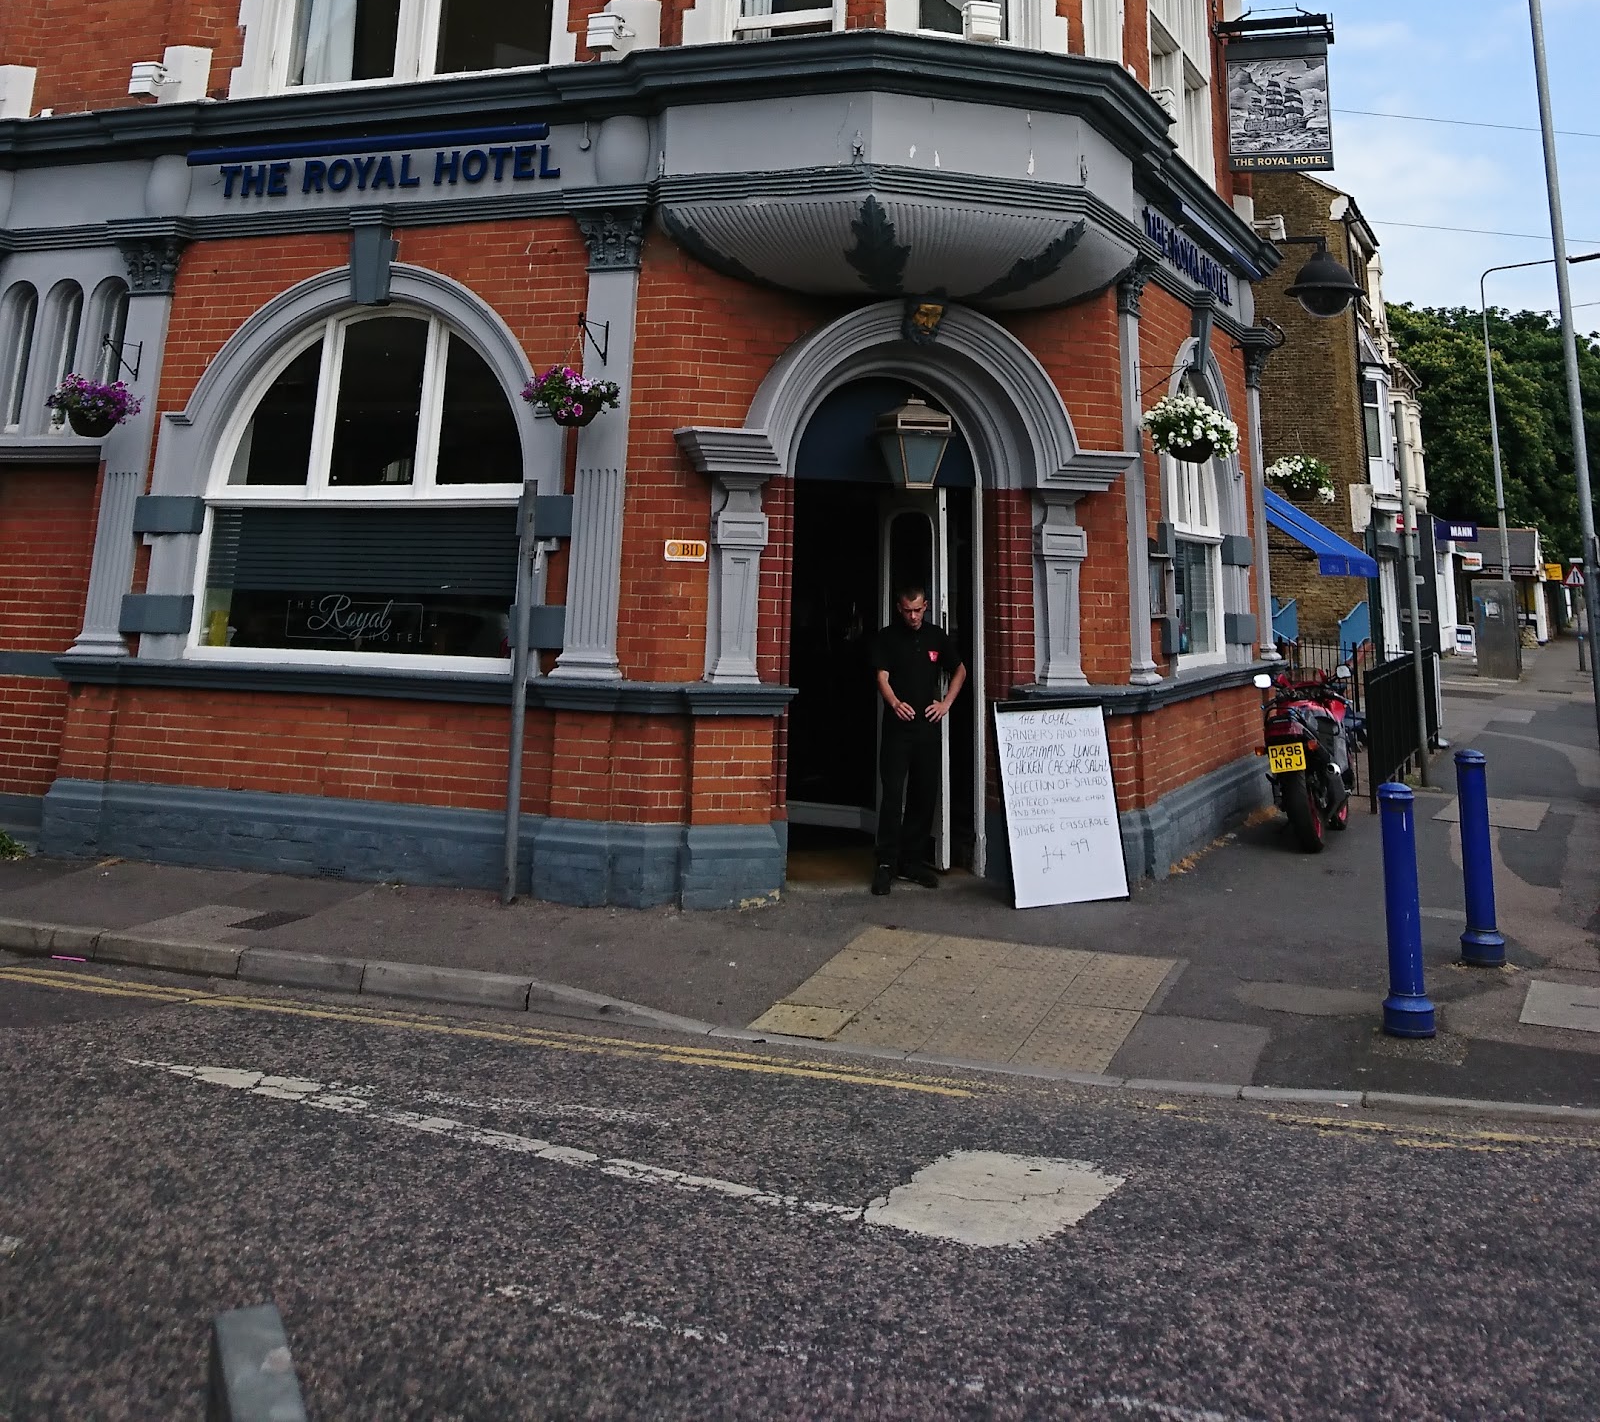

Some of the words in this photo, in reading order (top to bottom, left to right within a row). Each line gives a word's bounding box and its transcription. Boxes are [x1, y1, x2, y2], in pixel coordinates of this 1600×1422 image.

[1234, 158, 1254, 166] THE
[1257, 157, 1291, 166] ROYAL
[1293, 155, 1328, 165] HOTEL
[220, 161, 290, 197] THE
[302, 153, 420, 194] ROYAL
[433, 144, 561, 185] HOTEL
[1142, 206, 1169, 259] THE
[1168, 228, 1203, 284] ROYAL
[1450, 526, 1473, 538] MANN
[287, 600, 315, 610] THE
[307, 594, 394, 640] Royal
[369, 632, 424, 643] HOTEL
[1019, 714, 1035, 725] THE
[1005, 727, 1053, 742] BANGERS
[1056, 728, 1077, 740] AND
[1006, 743, 1066, 759] PLOUGHMANS
[1073, 744, 1101, 758] LUNCH
[1270, 745, 1302, 759] D496
[1008, 759, 1044, 776] CHICKEN
[1048, 759, 1083, 776] CAESAR
[1007, 779, 1055, 796] SELECTION
[1058, 778, 1073, 790] OF
[1074, 776, 1108, 788] SALADS
[1009, 797, 1049, 809] BATTERED
[1011, 809, 1029, 817] AND
